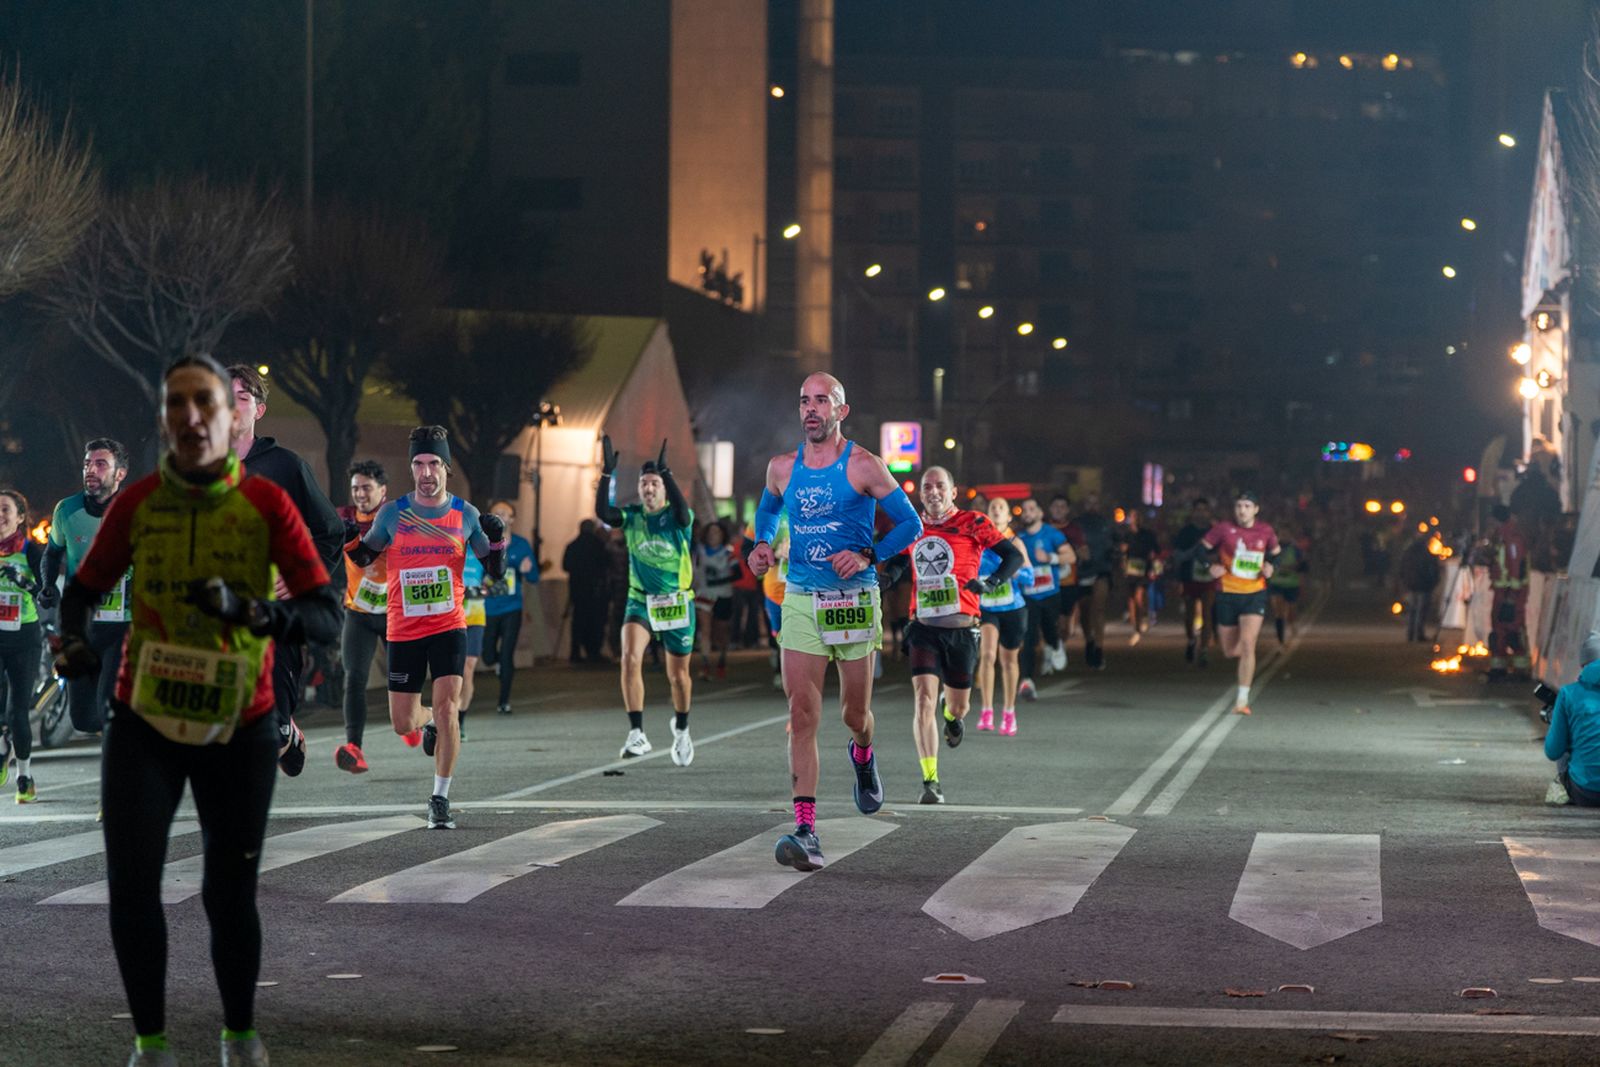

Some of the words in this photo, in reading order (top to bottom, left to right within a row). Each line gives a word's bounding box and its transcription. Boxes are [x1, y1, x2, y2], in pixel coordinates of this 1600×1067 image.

[801, 495, 818, 512] 25
[412, 583, 443, 600] 5812
[825, 607, 866, 625] 8699
[155, 679, 222, 715] 4084
